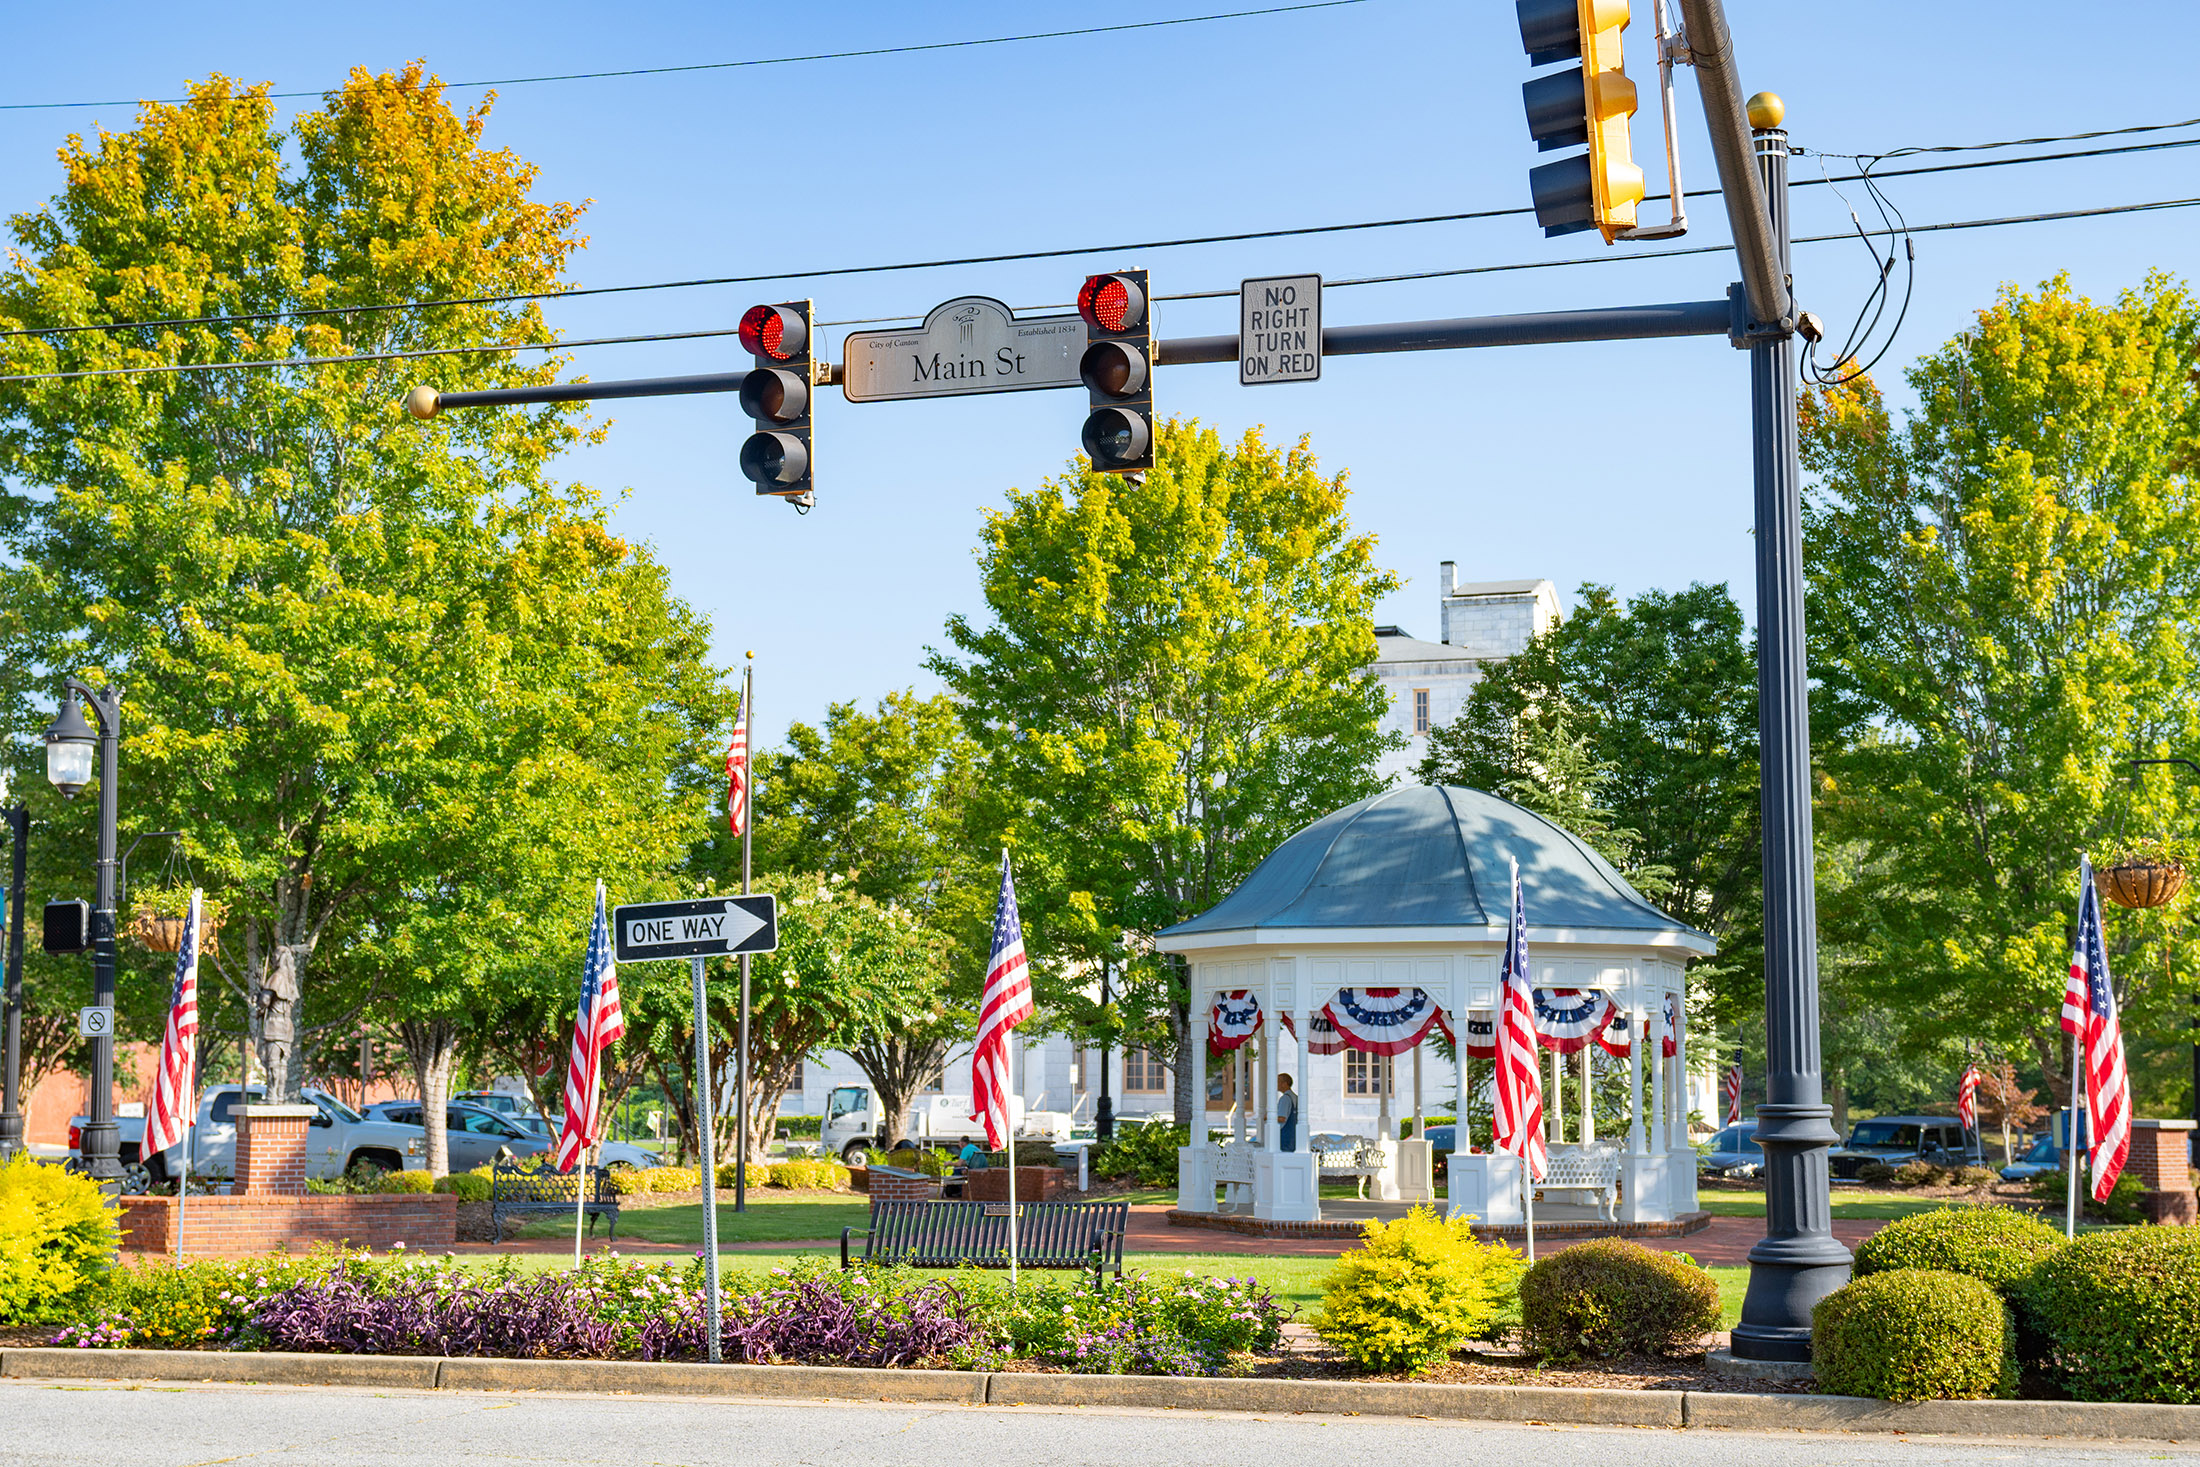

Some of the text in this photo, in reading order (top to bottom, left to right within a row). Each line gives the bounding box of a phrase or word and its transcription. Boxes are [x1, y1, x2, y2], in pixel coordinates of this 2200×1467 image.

[1265, 286, 1296, 307] NO
[1252, 307, 1309, 330] RIGHT
[1017, 325, 1076, 337] Established 1834
[1255, 330, 1306, 353] TURN
[869, 339, 919, 350] City of Canton
[911, 346, 1026, 383] Main St
[1245, 353, 1315, 376] ON RED
[632, 916, 726, 943] ONE WAY
